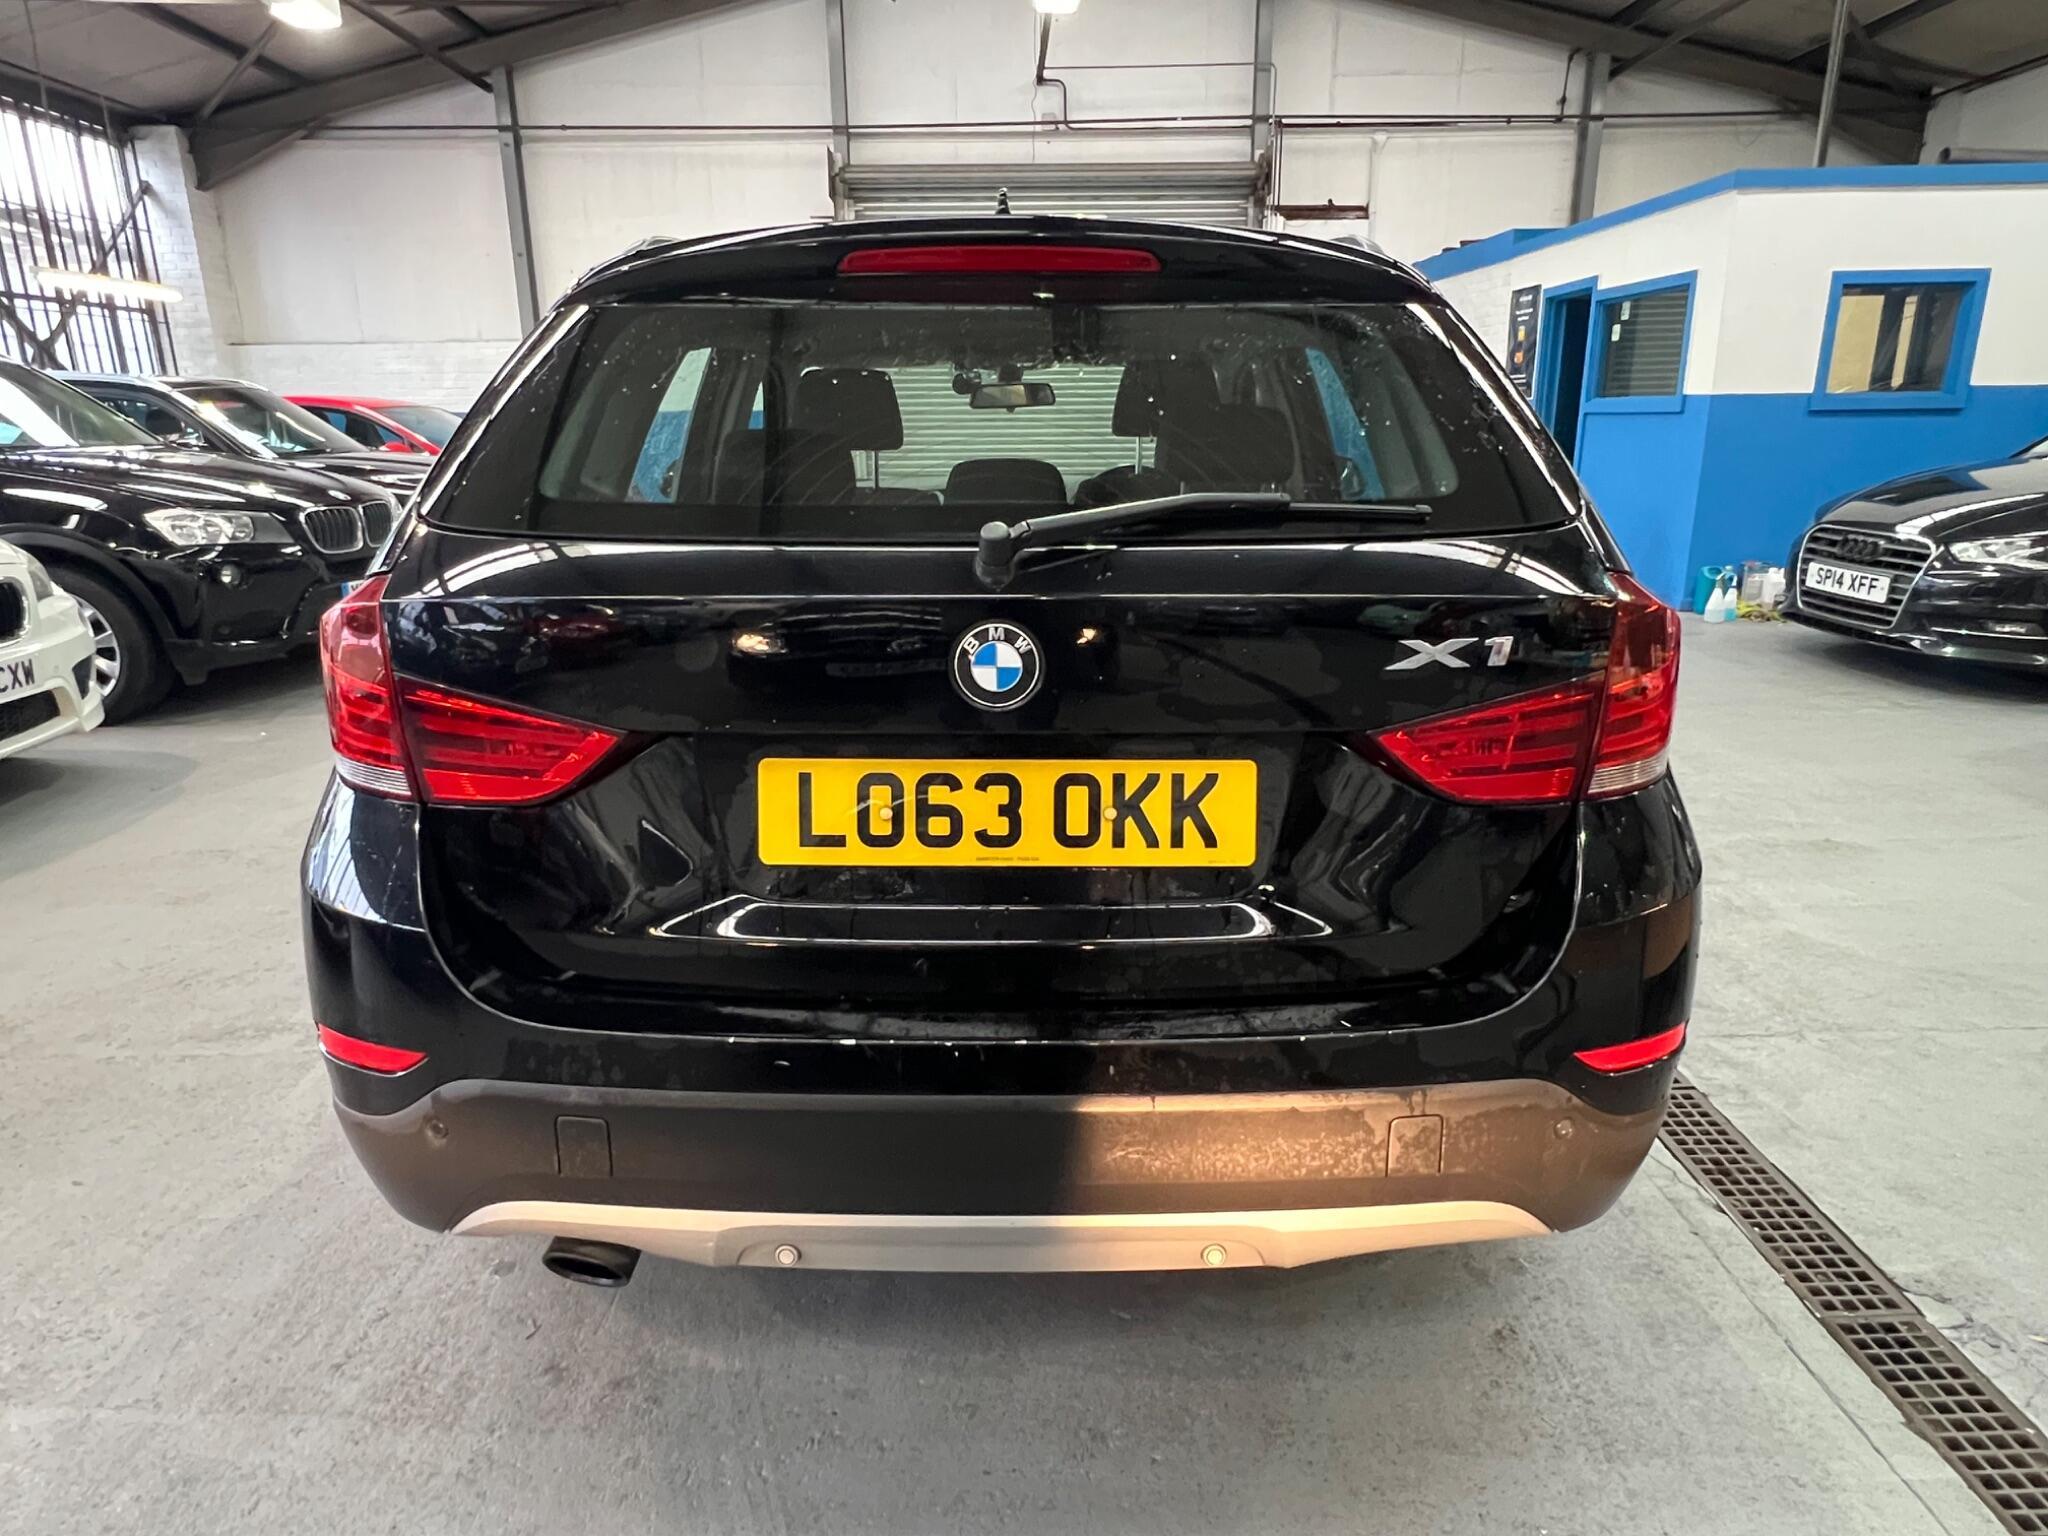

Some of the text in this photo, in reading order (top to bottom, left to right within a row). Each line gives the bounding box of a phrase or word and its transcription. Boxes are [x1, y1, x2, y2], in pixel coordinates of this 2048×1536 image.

[1815, 567, 1880, 596] SP14 XFF
[963, 627, 1032, 655] BMW
[1384, 635, 1514, 670] X1
[798, 772, 1219, 849] LO63 OKK
